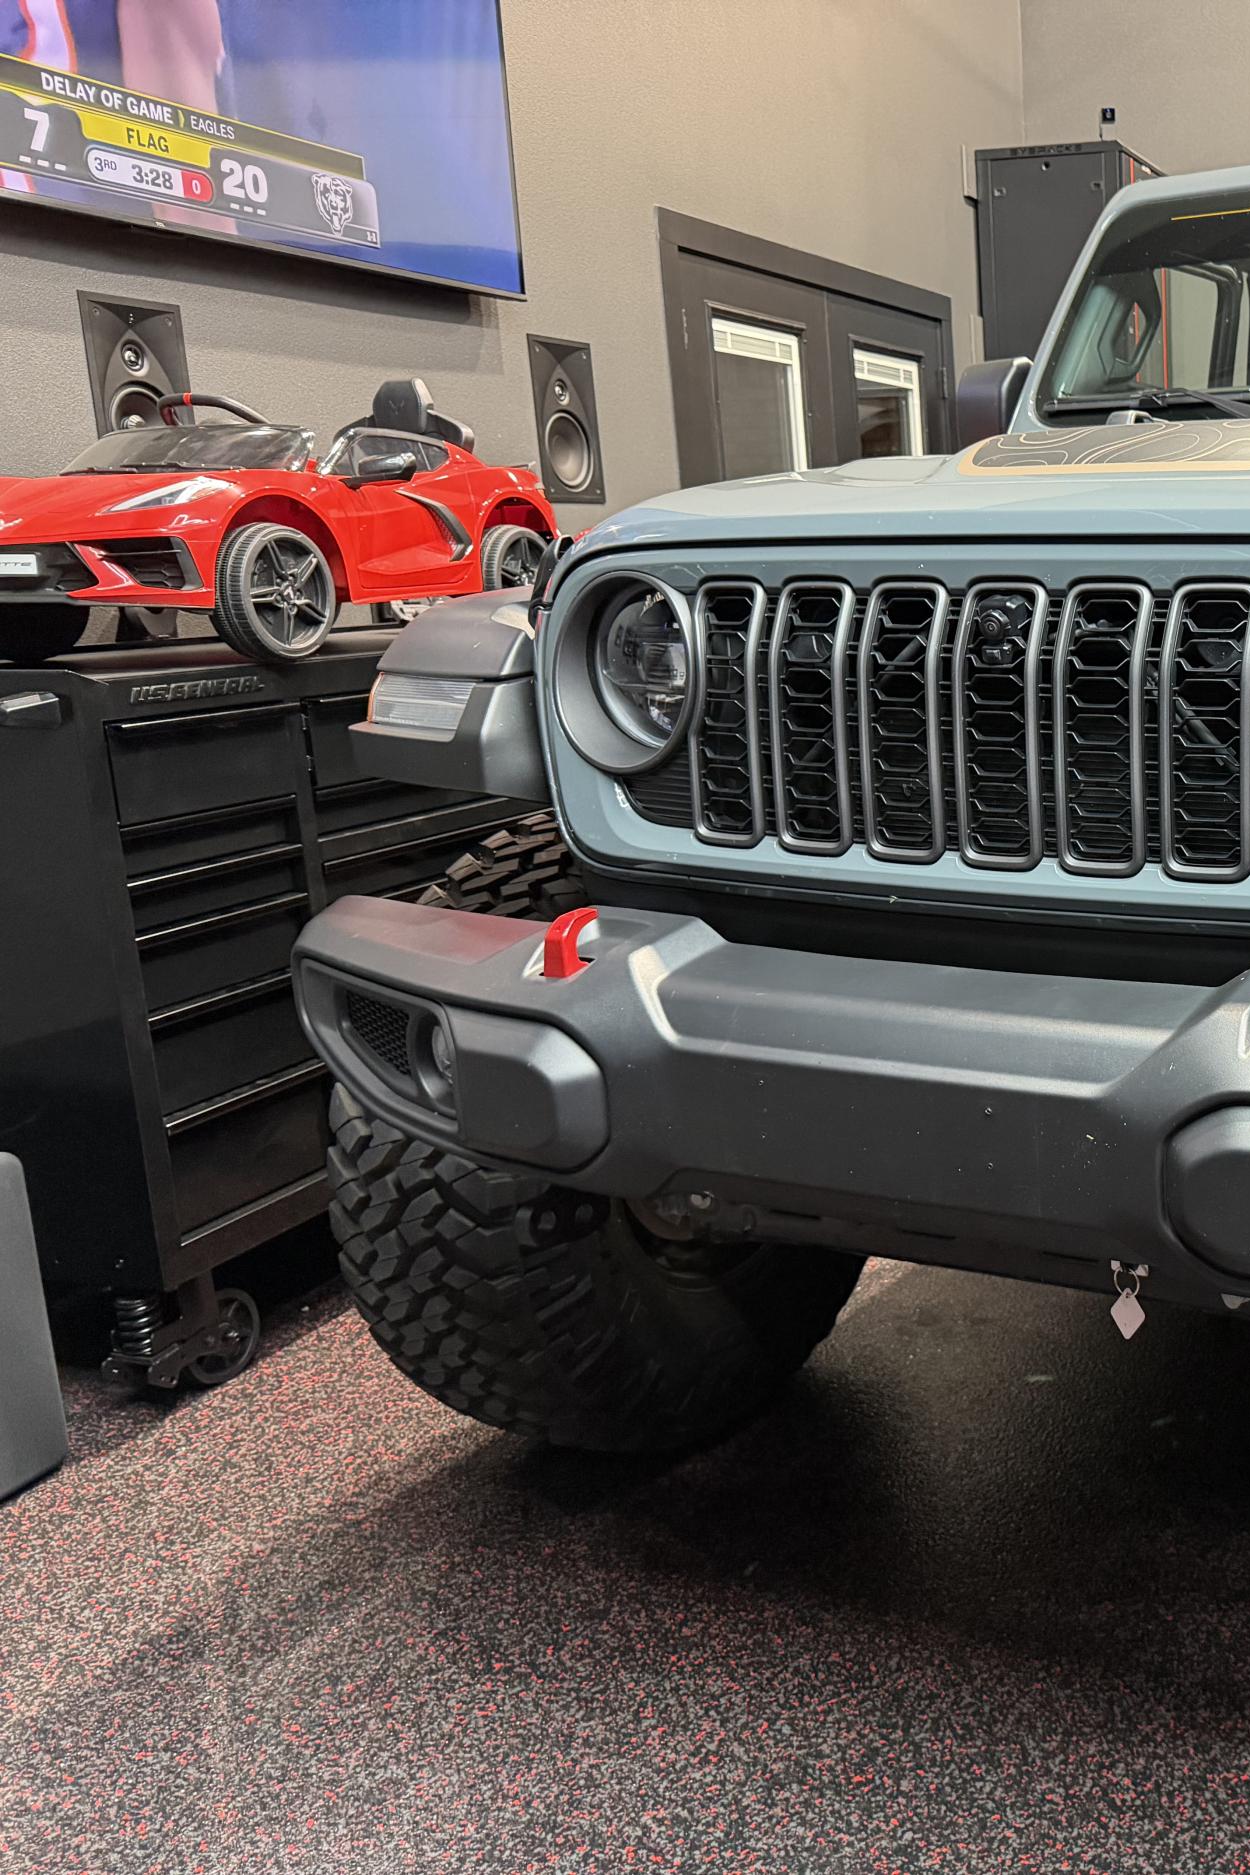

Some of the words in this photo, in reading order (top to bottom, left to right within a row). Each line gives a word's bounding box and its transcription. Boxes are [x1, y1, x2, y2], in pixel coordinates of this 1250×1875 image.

[41, 72, 95, 102] DELAY
[101, 90, 121, 109] OF
[127, 97, 173, 124] GAME
[191, 115, 235, 140] EAGLES
[24, 107, 50, 152] 7
[126, 127, 169, 153] FLAG
[94, 157, 117, 171] 3RD
[131, 163, 174, 190] 3:28
[192, 179, 201, 195] 0
[221, 159, 268, 203] 20
